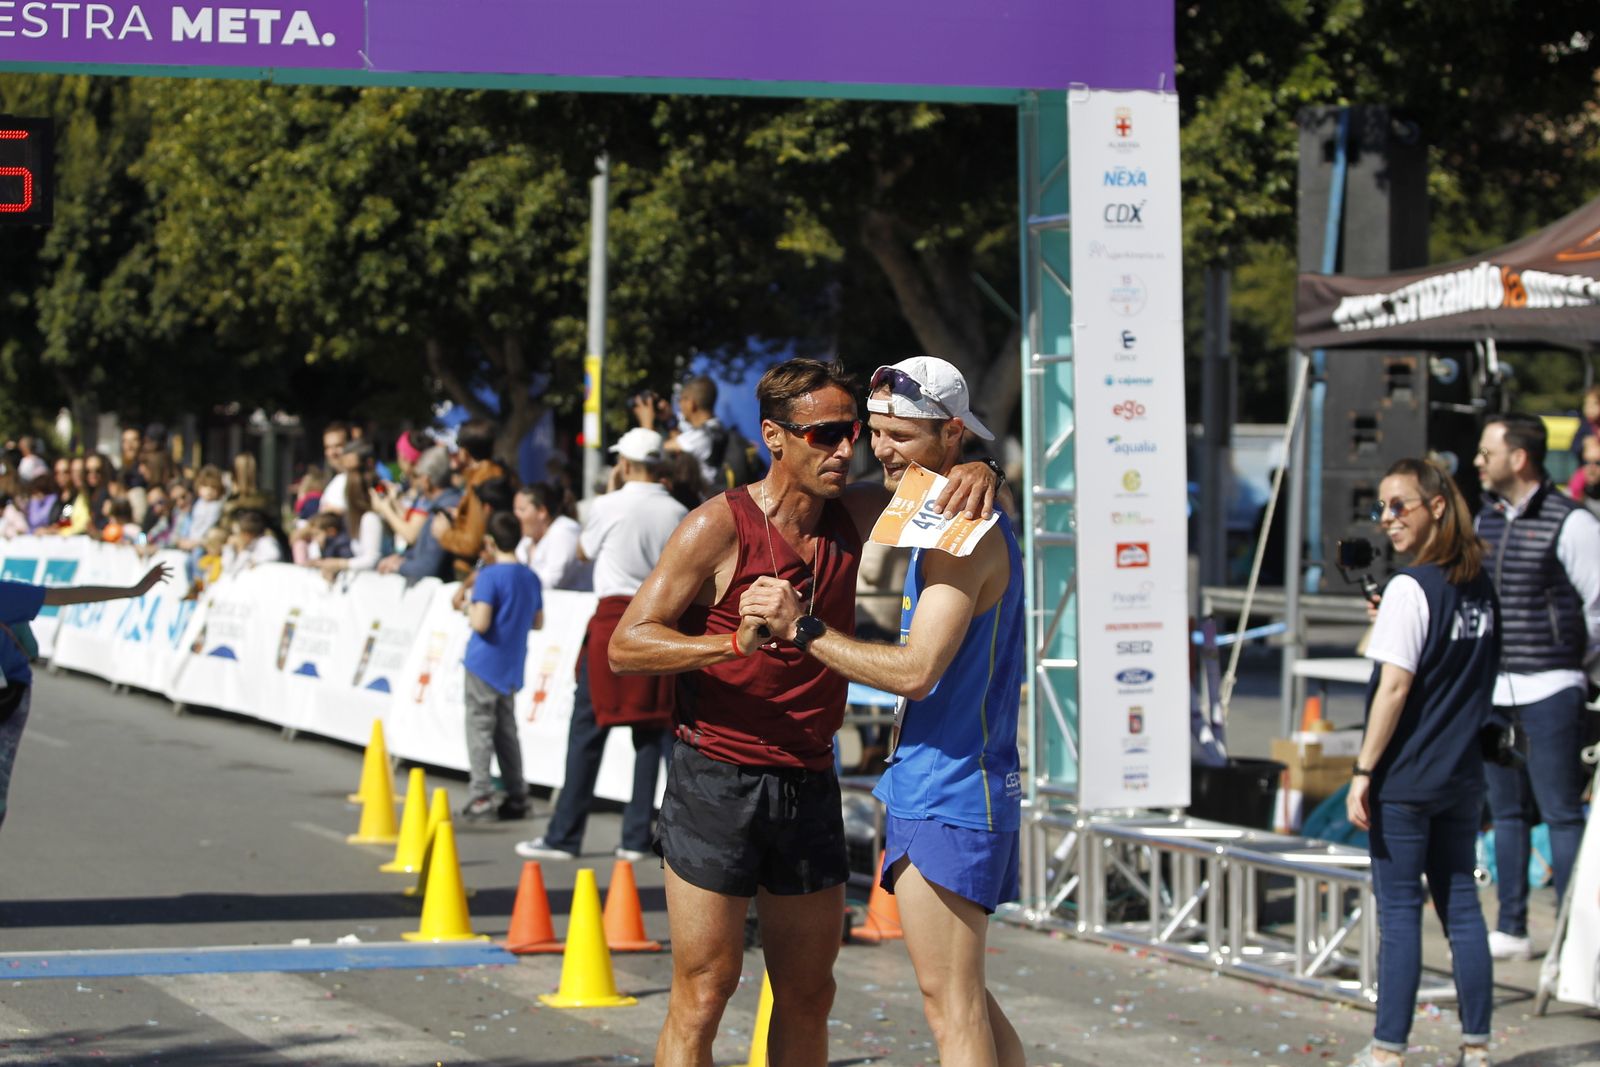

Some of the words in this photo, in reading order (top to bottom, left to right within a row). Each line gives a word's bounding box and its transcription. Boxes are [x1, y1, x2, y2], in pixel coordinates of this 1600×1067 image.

[171, 7, 336, 47] META.
[1104, 170, 1147, 187] NEXA
[1104, 200, 1144, 224] CDX
[1113, 400, 1146, 421] ego
[1114, 440, 1158, 455] aqualia
[1116, 640, 1154, 655] SER
